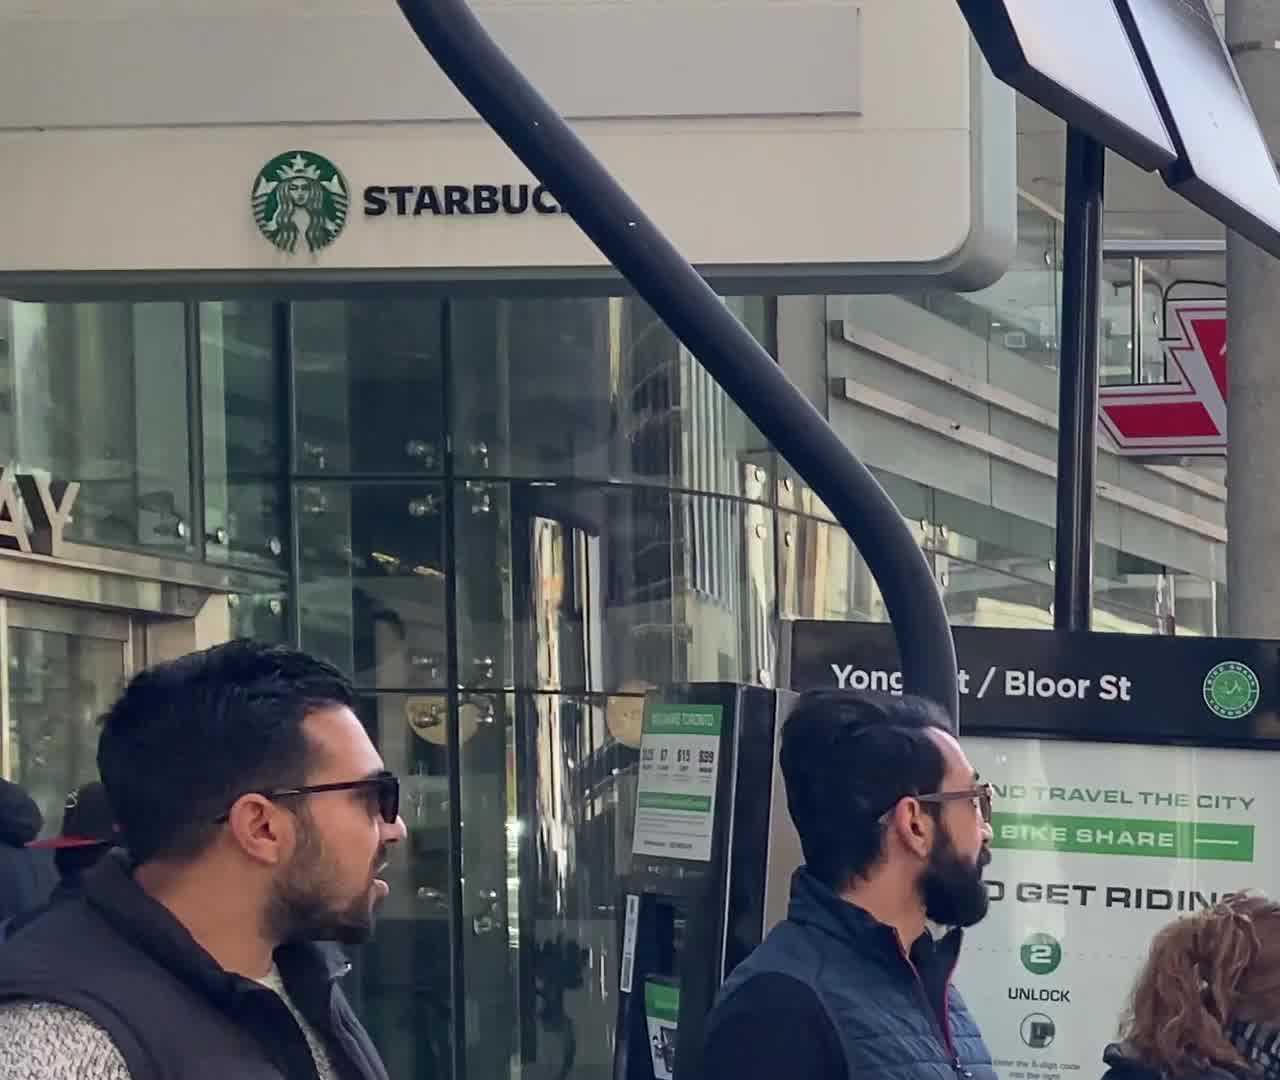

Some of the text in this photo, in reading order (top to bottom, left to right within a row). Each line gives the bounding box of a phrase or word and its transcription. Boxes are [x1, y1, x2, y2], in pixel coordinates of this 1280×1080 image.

[364, 184, 568, 216] STARBUC
[831, 664, 903, 695] Yong
[957, 669, 970, 694] t
[1005, 670, 1090, 698] Bloor
[1099, 675, 1131, 700] St
[990, 783, 1256, 811] ND TRAVEL THE CITY
[1001, 824, 1174, 848] BIKE SHARE
[1016, 882, 1097, 907] GET
[1105, 886, 1236, 912] RIDIN
[1030, 944, 1052, 963] 2
[1008, 987, 1071, 1002] UNLOCK
